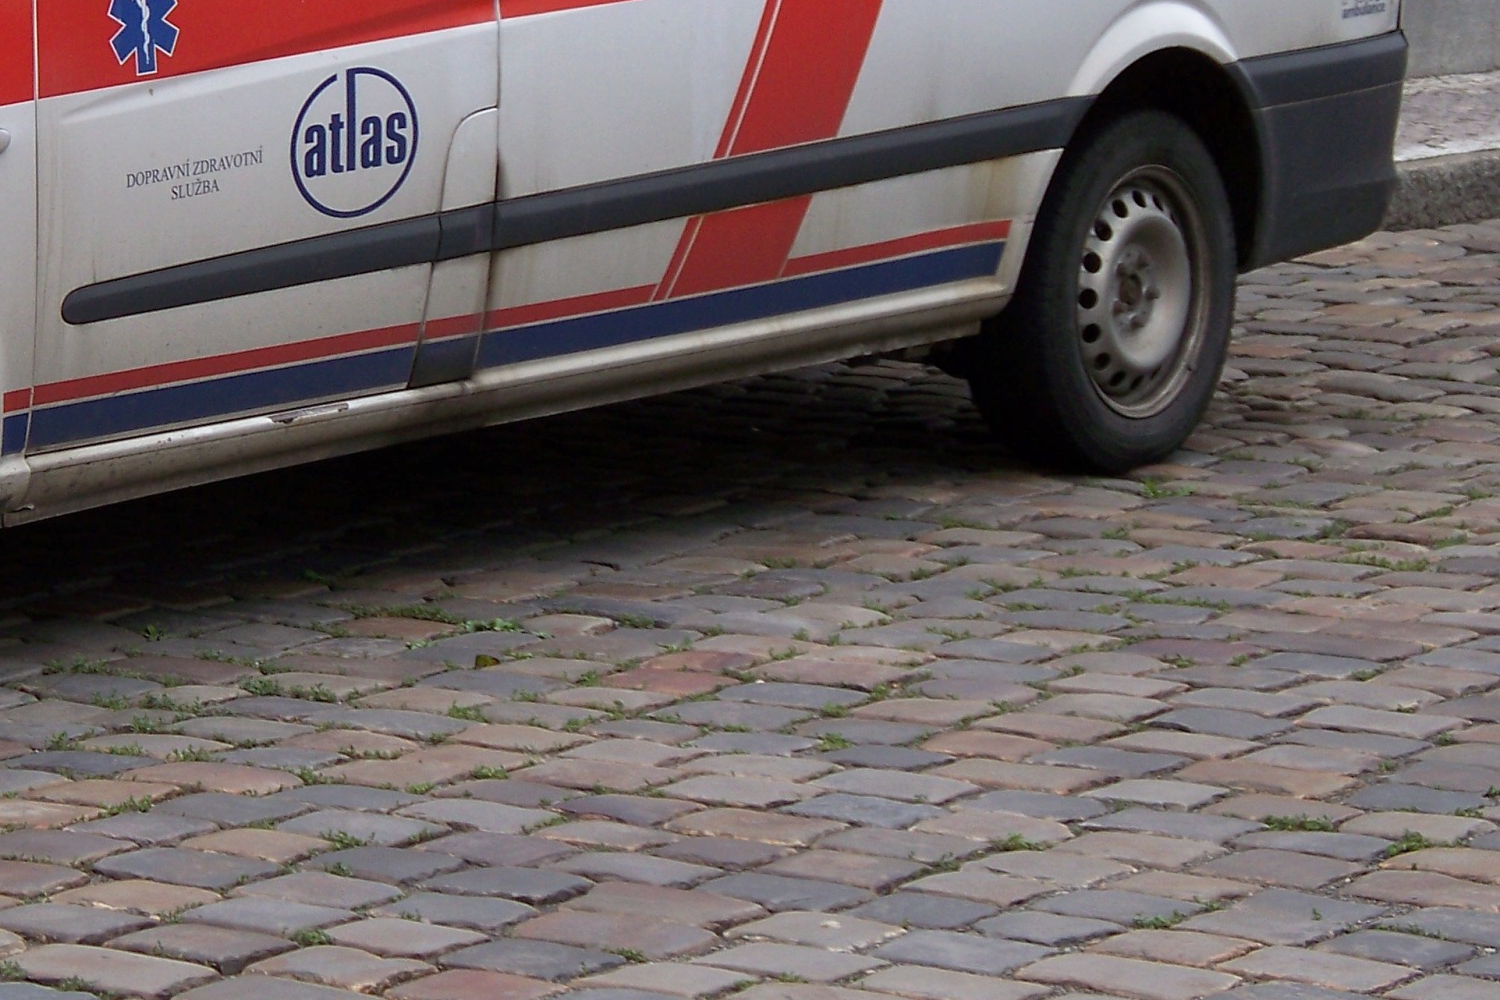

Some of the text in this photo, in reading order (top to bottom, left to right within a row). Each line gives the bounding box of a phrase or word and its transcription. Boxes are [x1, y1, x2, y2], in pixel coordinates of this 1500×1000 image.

[304, 67, 408, 179] atlas
[126, 145, 264, 188] DOPRAVNÍ ZDRAVOTNÍ
[171, 178, 220, 200] SLUŽBA
